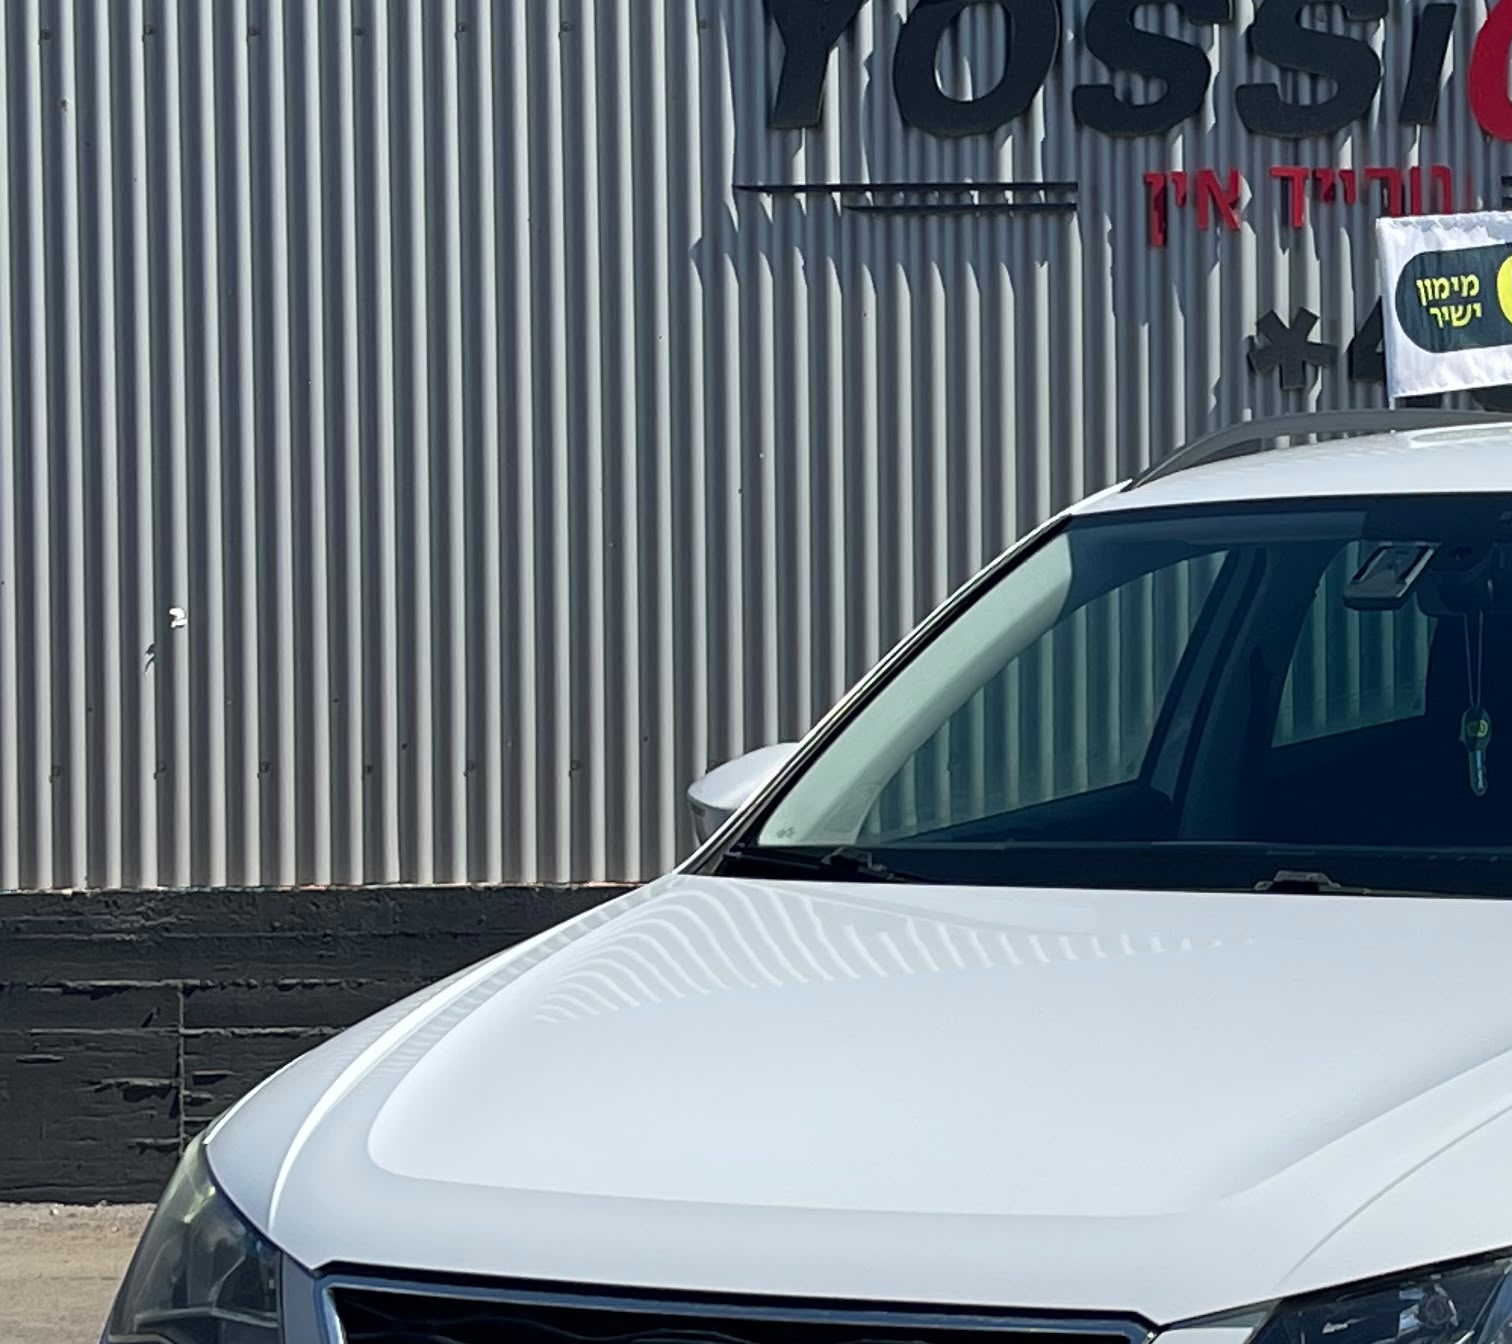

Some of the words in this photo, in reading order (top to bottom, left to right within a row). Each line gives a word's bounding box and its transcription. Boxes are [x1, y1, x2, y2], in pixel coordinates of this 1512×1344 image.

[1143, 167, 1241, 248] אין
[1415, 273, 1480, 307] מימון
[1429, 302, 1483, 329] ישיר
